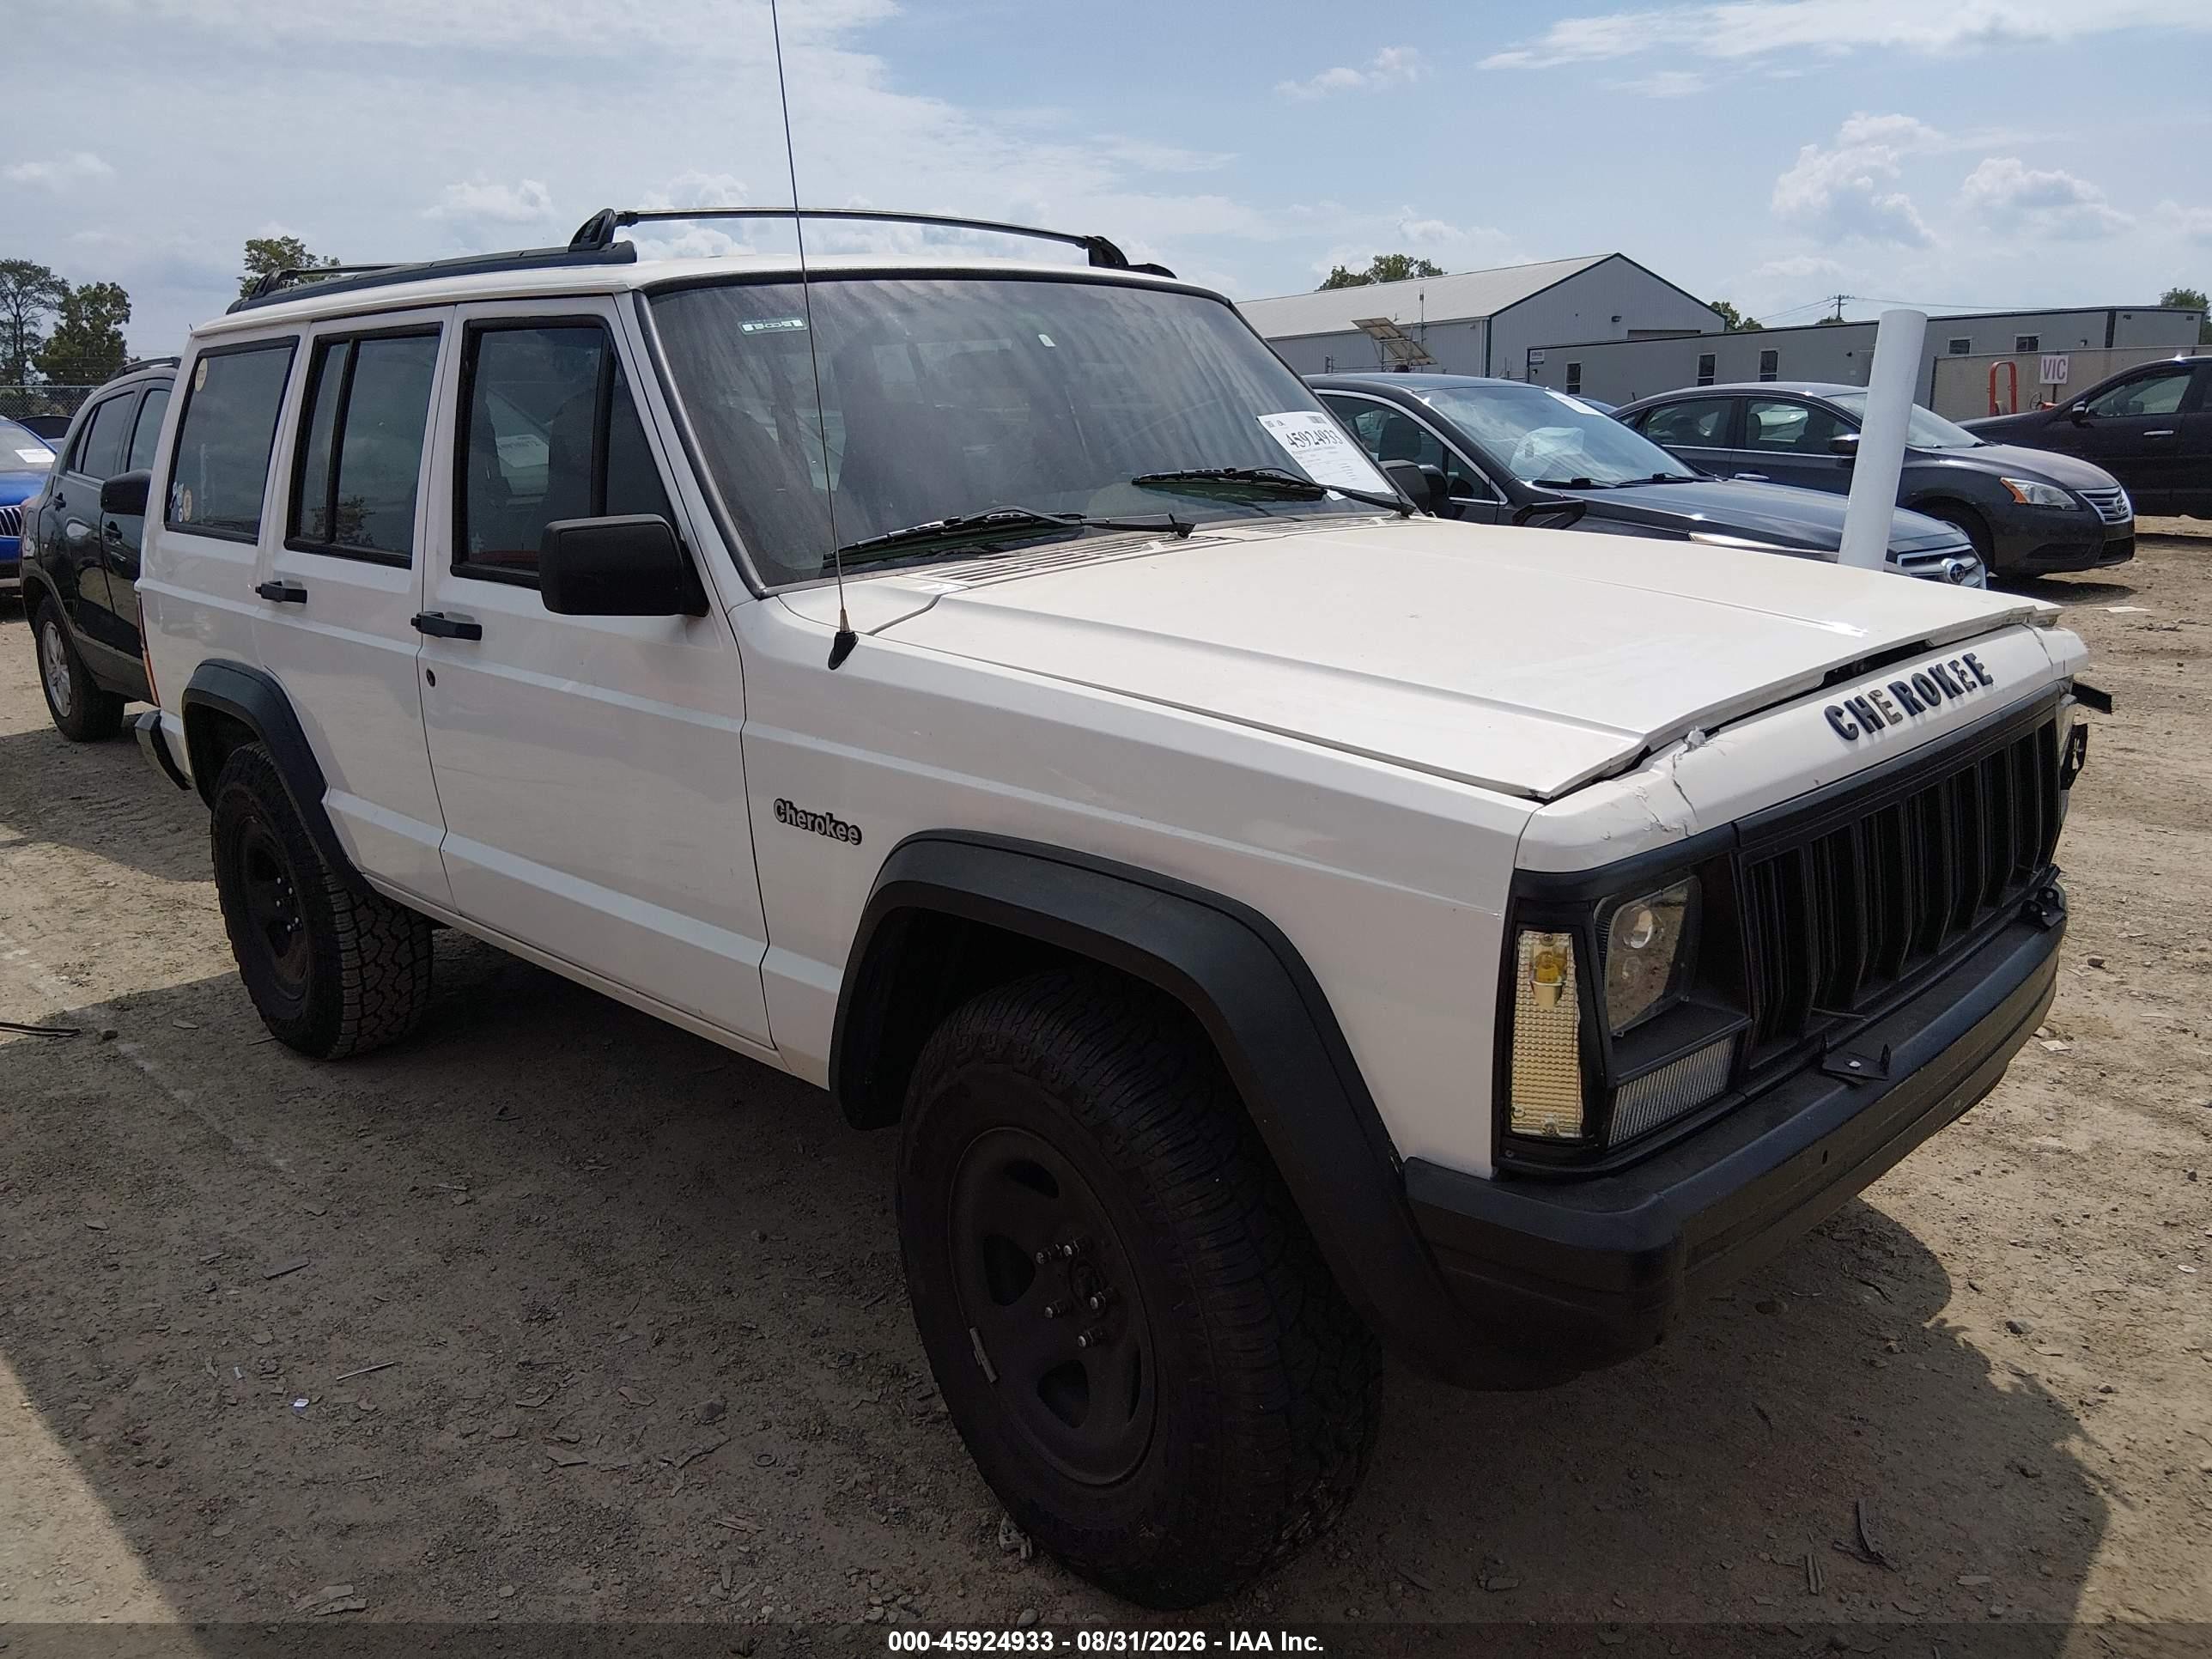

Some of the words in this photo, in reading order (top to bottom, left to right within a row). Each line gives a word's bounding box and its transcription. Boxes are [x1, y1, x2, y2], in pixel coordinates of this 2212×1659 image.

[2044, 358, 2066, 380] VIC
[1285, 429, 1343, 448] 45924933
[1824, 652, 1994, 741] CHEROKEE
[773, 798, 862, 846] Cherokee
